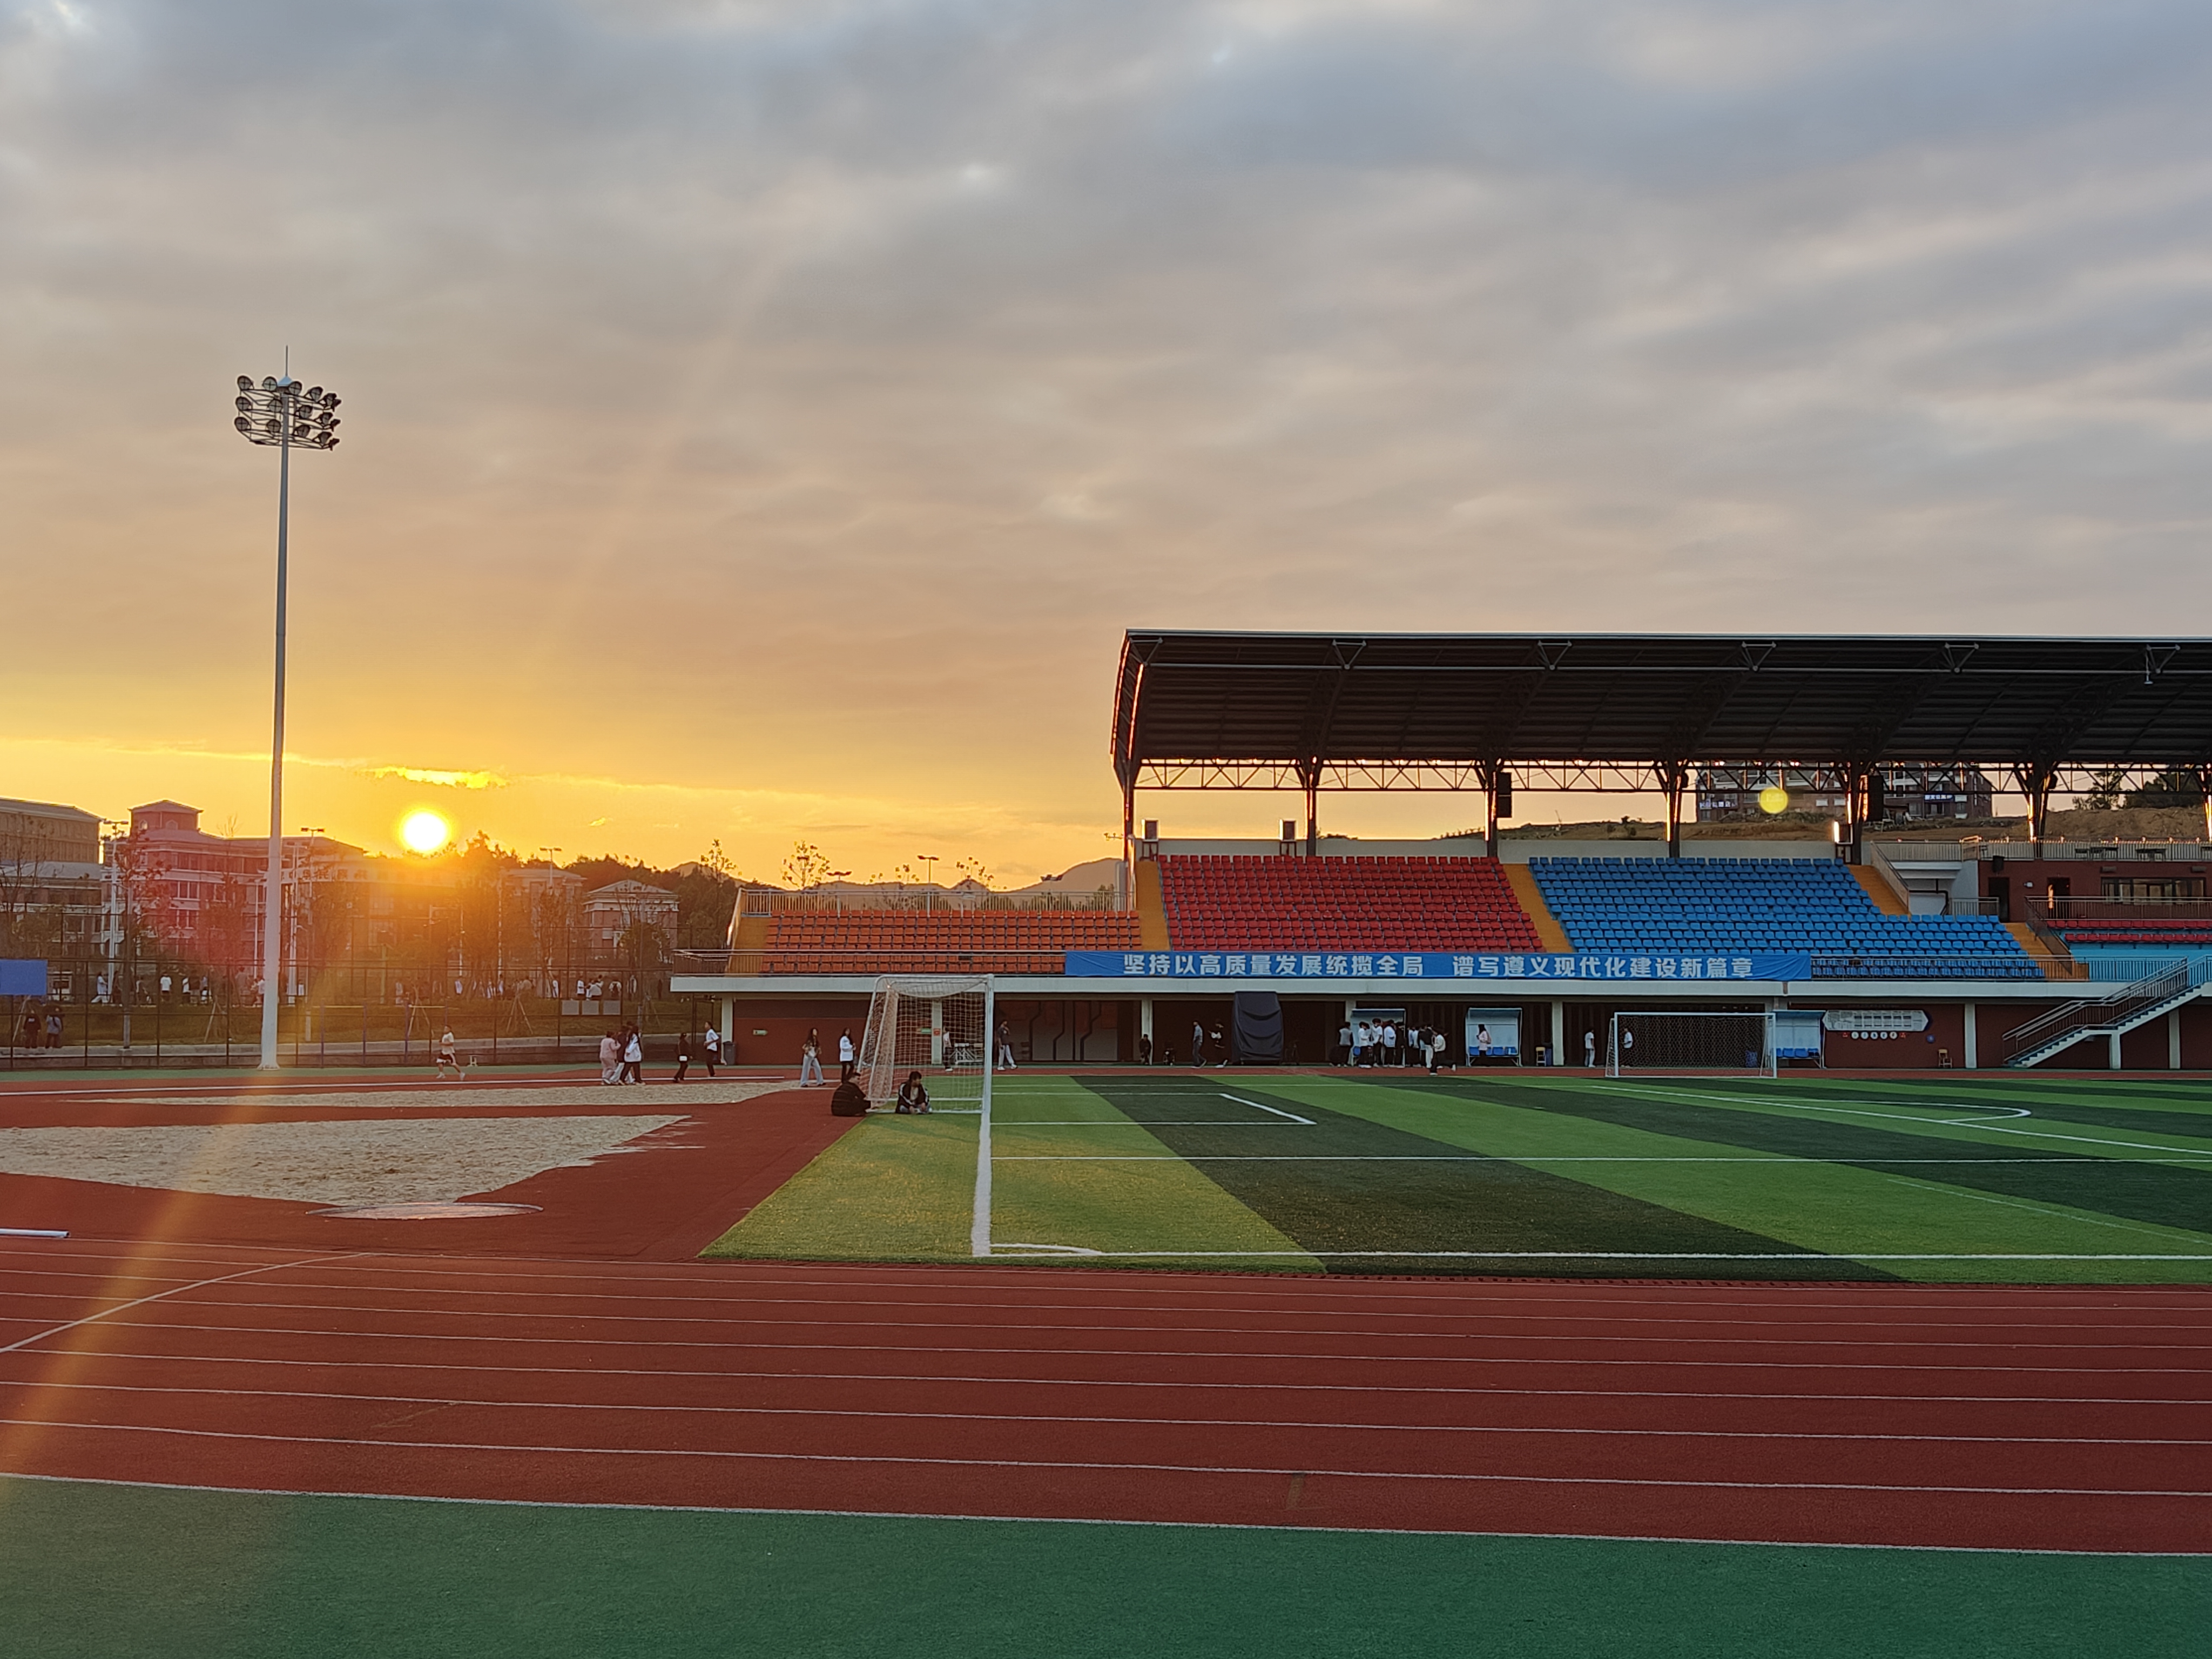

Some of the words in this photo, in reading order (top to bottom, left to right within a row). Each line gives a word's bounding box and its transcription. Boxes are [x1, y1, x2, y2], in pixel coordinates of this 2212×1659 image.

[1123, 954, 1423, 976] 坚持以高质量发展统揽全局
[1453, 956, 1753, 978] 谱写遵义现代化建设新篇章
